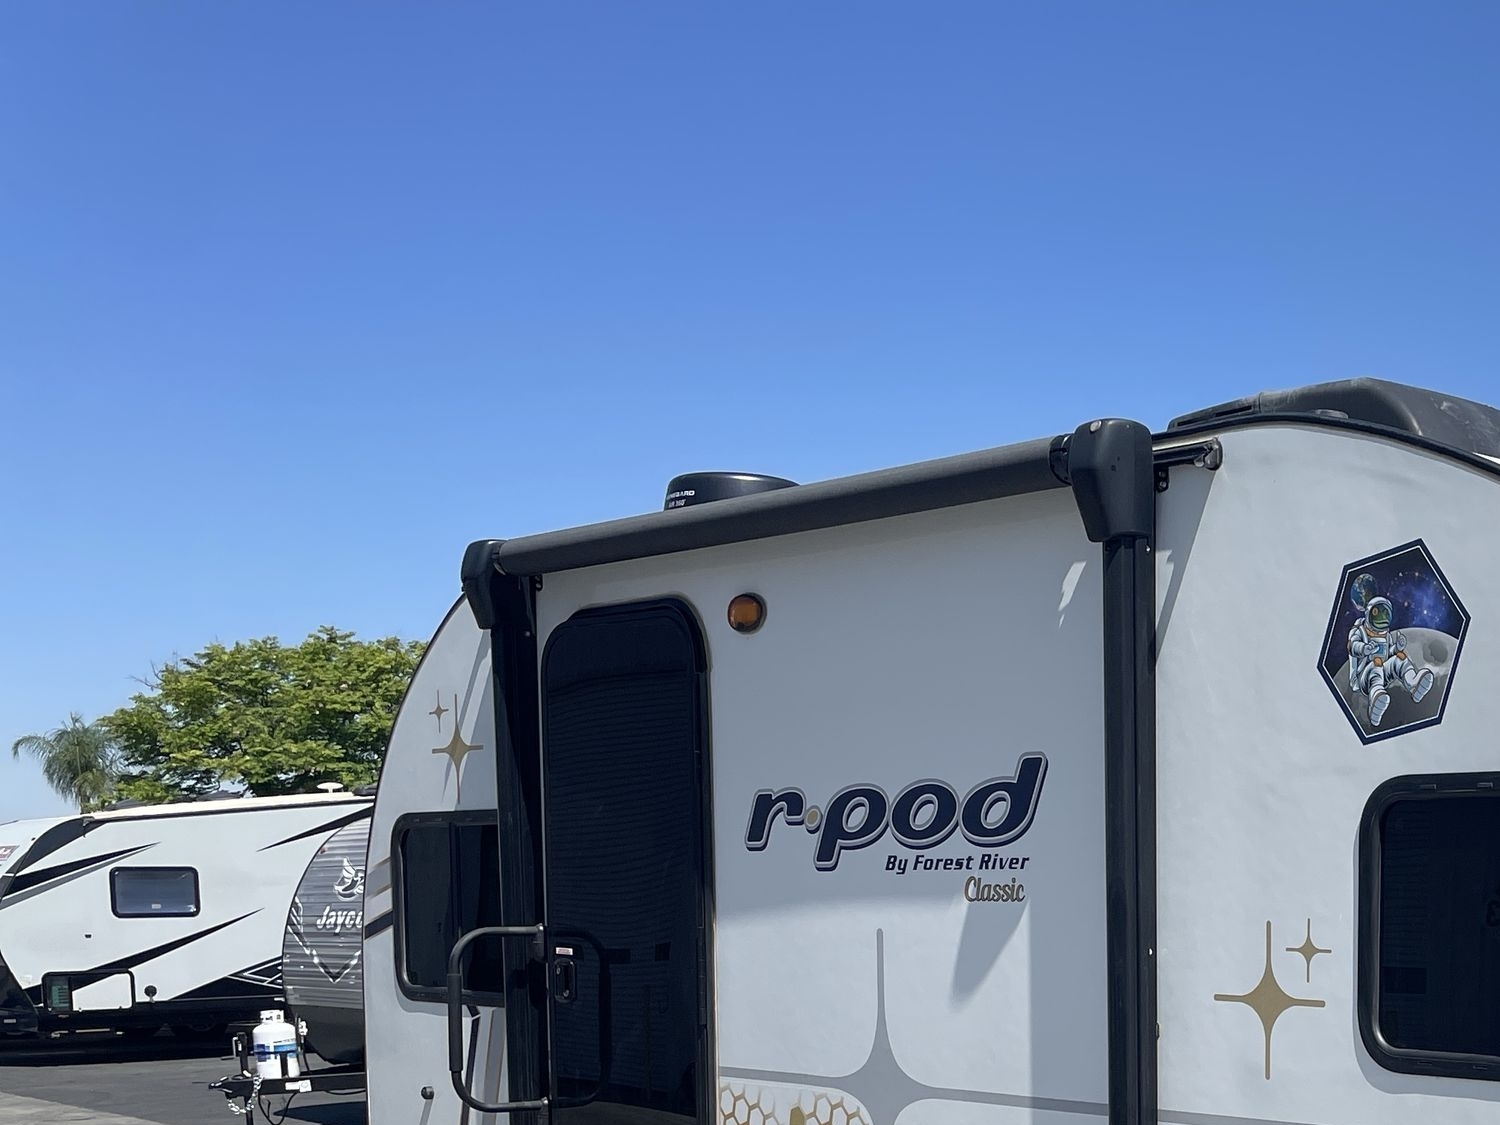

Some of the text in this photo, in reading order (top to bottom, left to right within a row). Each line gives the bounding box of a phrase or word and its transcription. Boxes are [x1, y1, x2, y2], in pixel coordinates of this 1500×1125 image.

[885, 854, 1030, 874] By Forest River
[964, 876, 1026, 902] Classic
